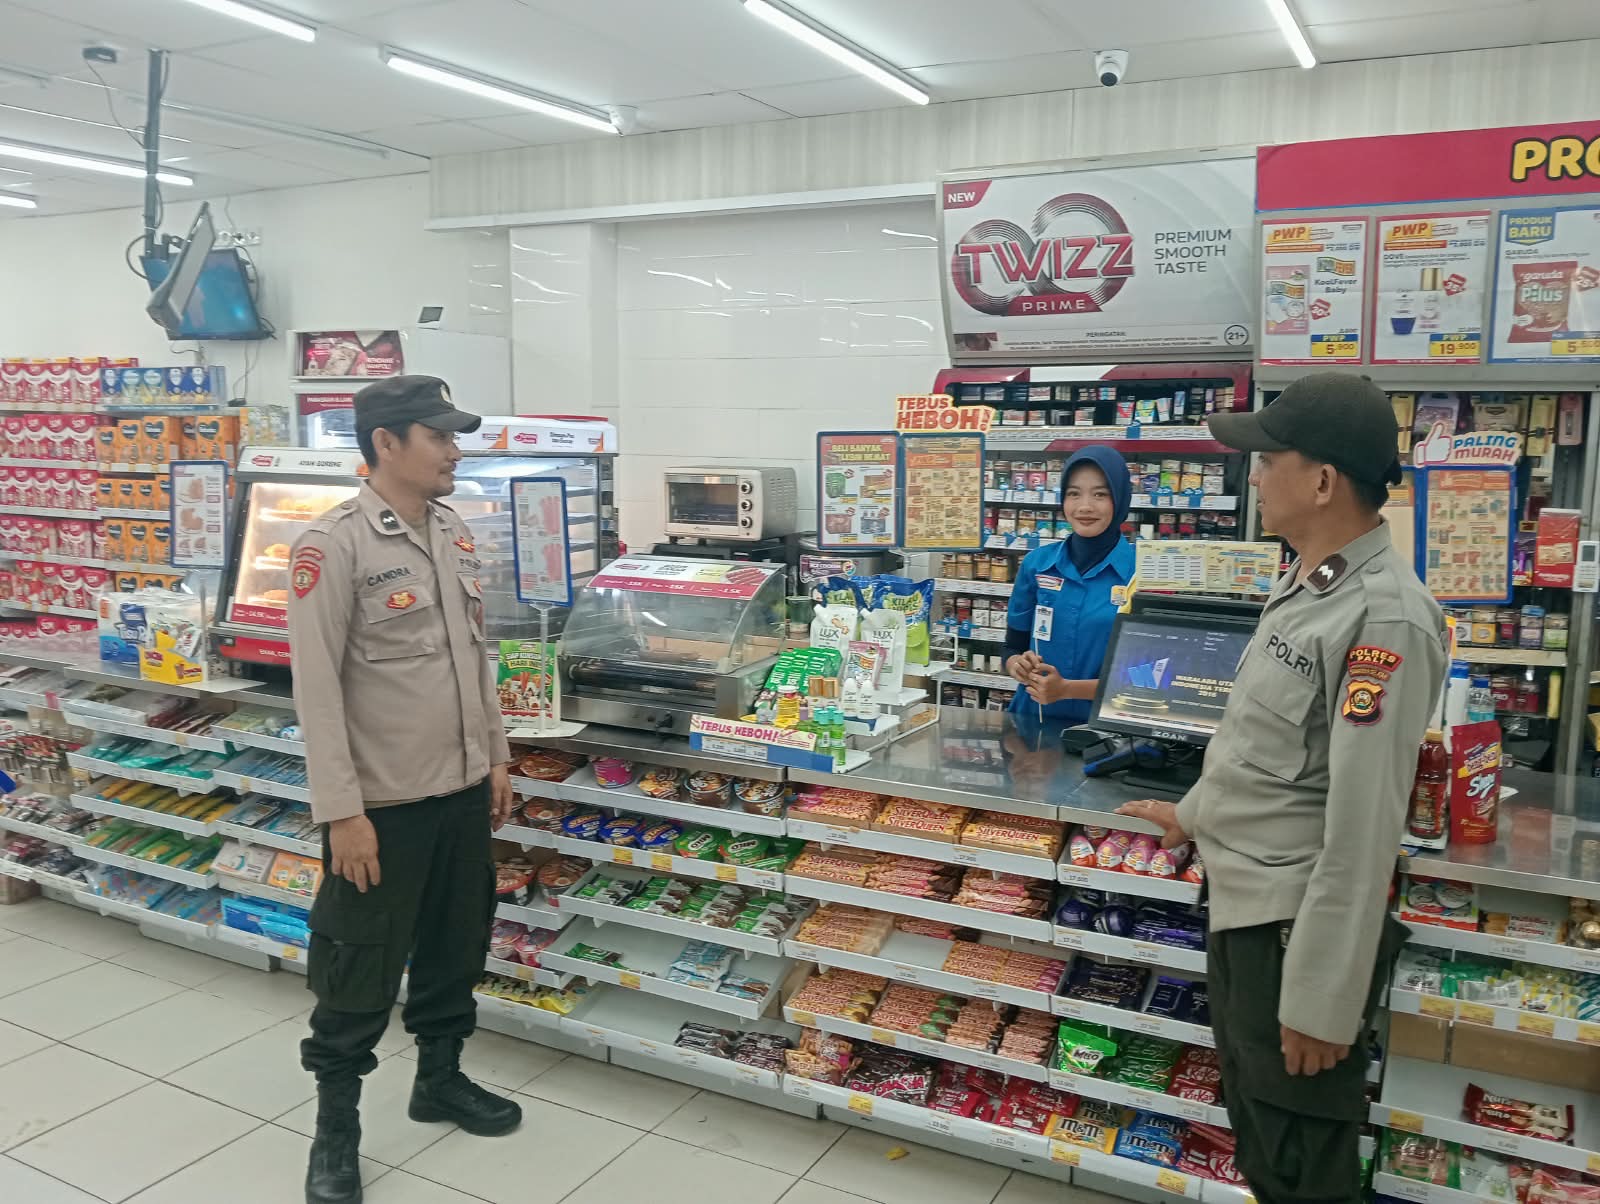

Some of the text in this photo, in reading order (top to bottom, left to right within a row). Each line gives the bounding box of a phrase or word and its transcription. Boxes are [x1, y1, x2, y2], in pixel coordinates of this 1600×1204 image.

[948, 191, 976, 203] NEW
[1154, 228, 1232, 245] PREMIUM
[1272, 226, 1307, 240] PWP
[1391, 222, 1429, 237] PWP
[1508, 225, 1552, 239] BARU
[957, 233, 1135, 287] TWIZZ
[1154, 244, 1226, 261] SMOOTH
[1154, 260, 1208, 275] TASTE
[1022, 299, 1087, 313] PRIME
[1227, 331, 1245, 341] 21+
[897, 396, 949, 411] TEBUS
[896, 407, 991, 432] HEBOH!
[1453, 434, 1518, 449] PALING
[1455, 447, 1515, 462] MURAH
[367, 567, 411, 588] CANDRA
[819, 627, 840, 639] LUX
[872, 630, 893, 640] LUX
[1265, 633, 1315, 677] POLRI
[1349, 648, 1398, 663] POLRES
[1357, 655, 1386, 665] PALI
[701, 720, 780, 742] TEBUS HEBOH!
[1072, 1049, 1101, 1061] MILO
